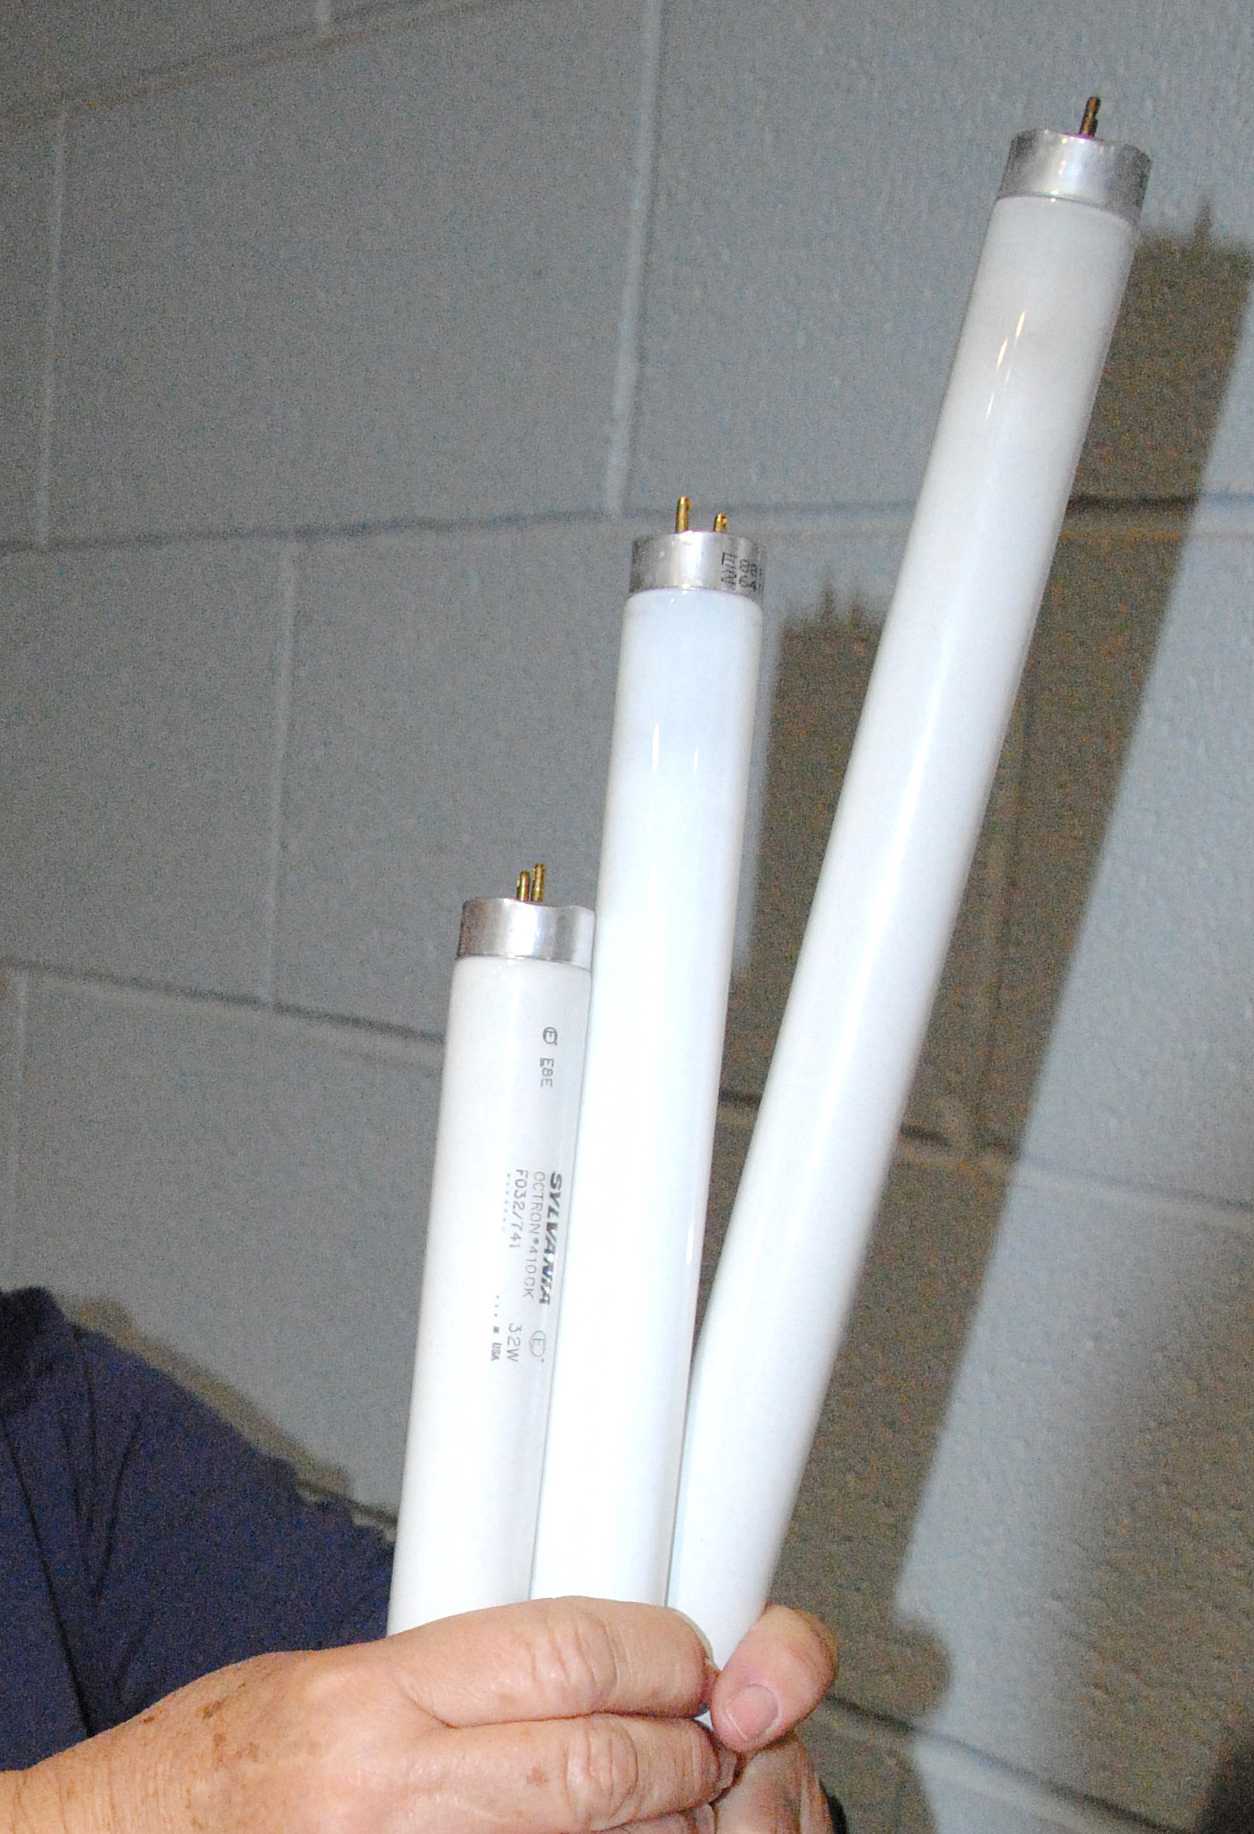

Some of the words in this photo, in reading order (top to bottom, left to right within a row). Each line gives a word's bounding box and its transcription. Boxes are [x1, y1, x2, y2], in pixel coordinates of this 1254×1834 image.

[539, 1172, 562, 1304] SYLVANIA
[490, 1342, 502, 1361] USA
[507, 1323, 522, 1362] 32W
